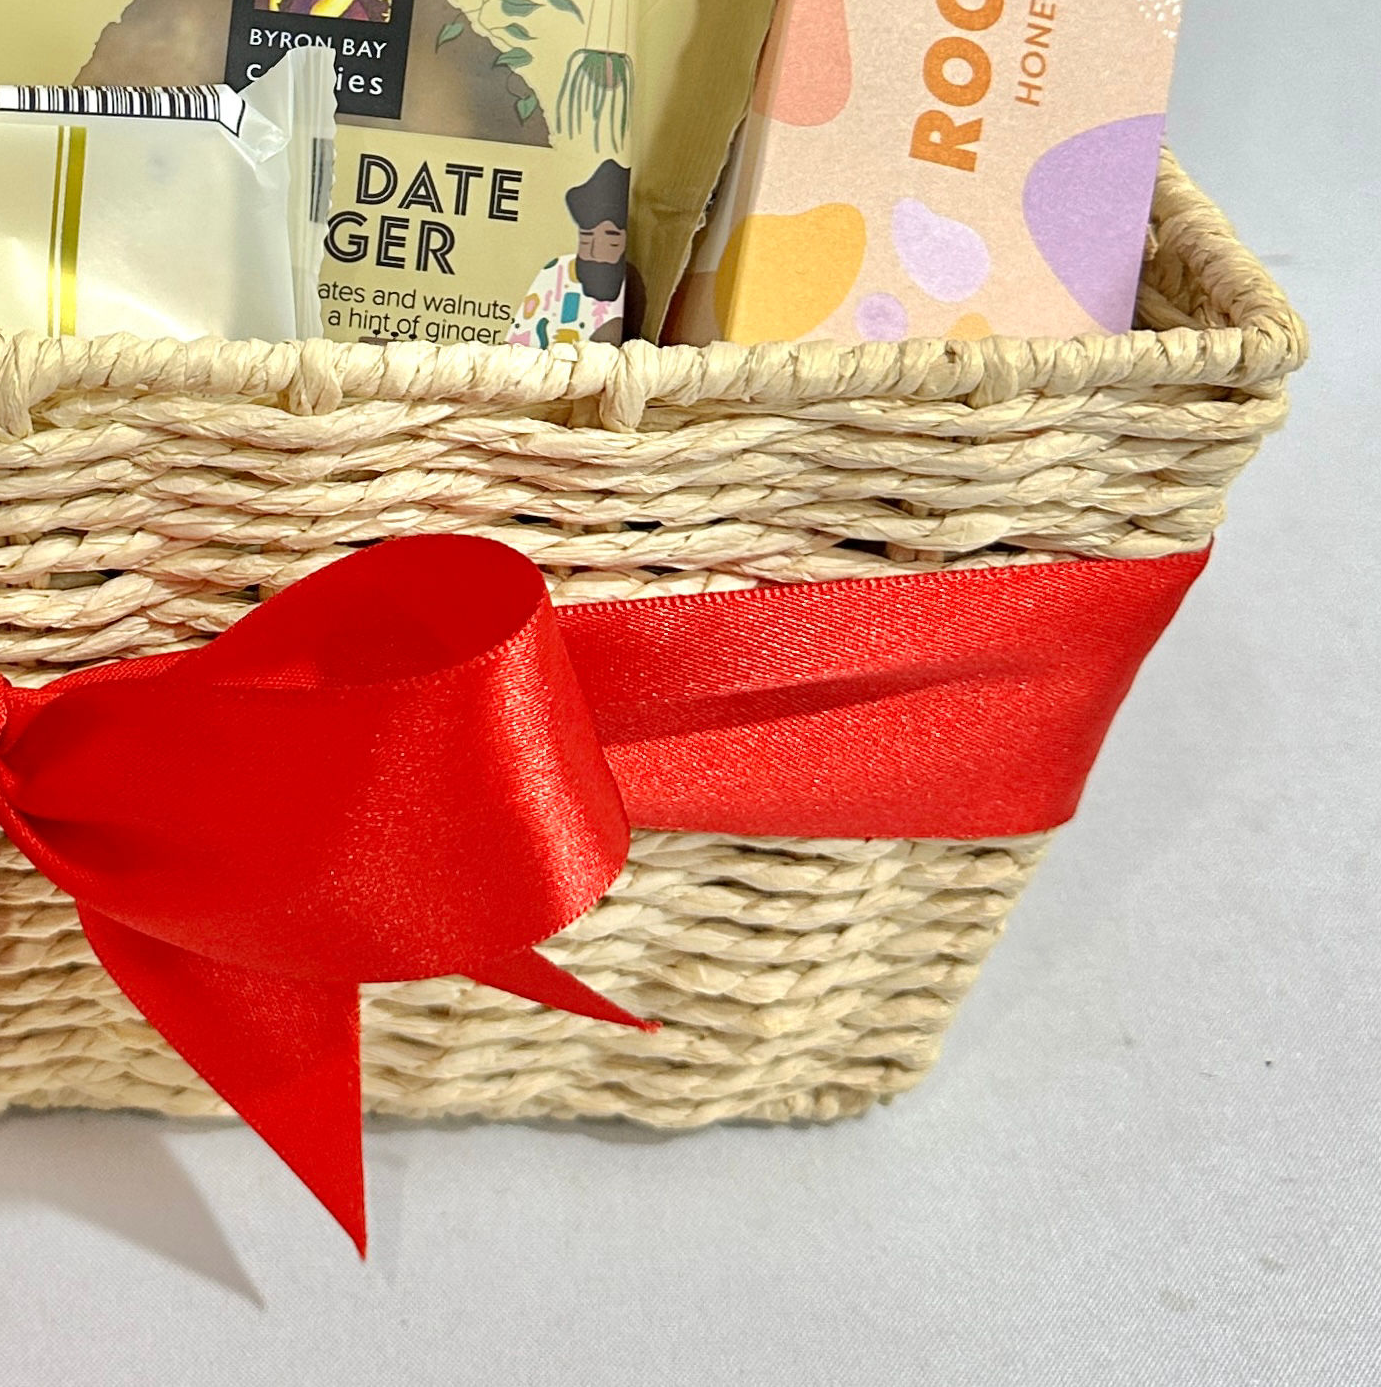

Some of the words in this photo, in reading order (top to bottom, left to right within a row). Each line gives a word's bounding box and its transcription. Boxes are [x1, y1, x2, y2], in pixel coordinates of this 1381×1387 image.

[342, 39, 387, 59] BAY
[355, 153, 524, 222] DATE
[327, 310, 341, 326] a
[348, 307, 391, 333] hint
[396, 314, 422, 336] of
[372, 289, 417, 310] and
[423, 294, 516, 324] walnuts,
